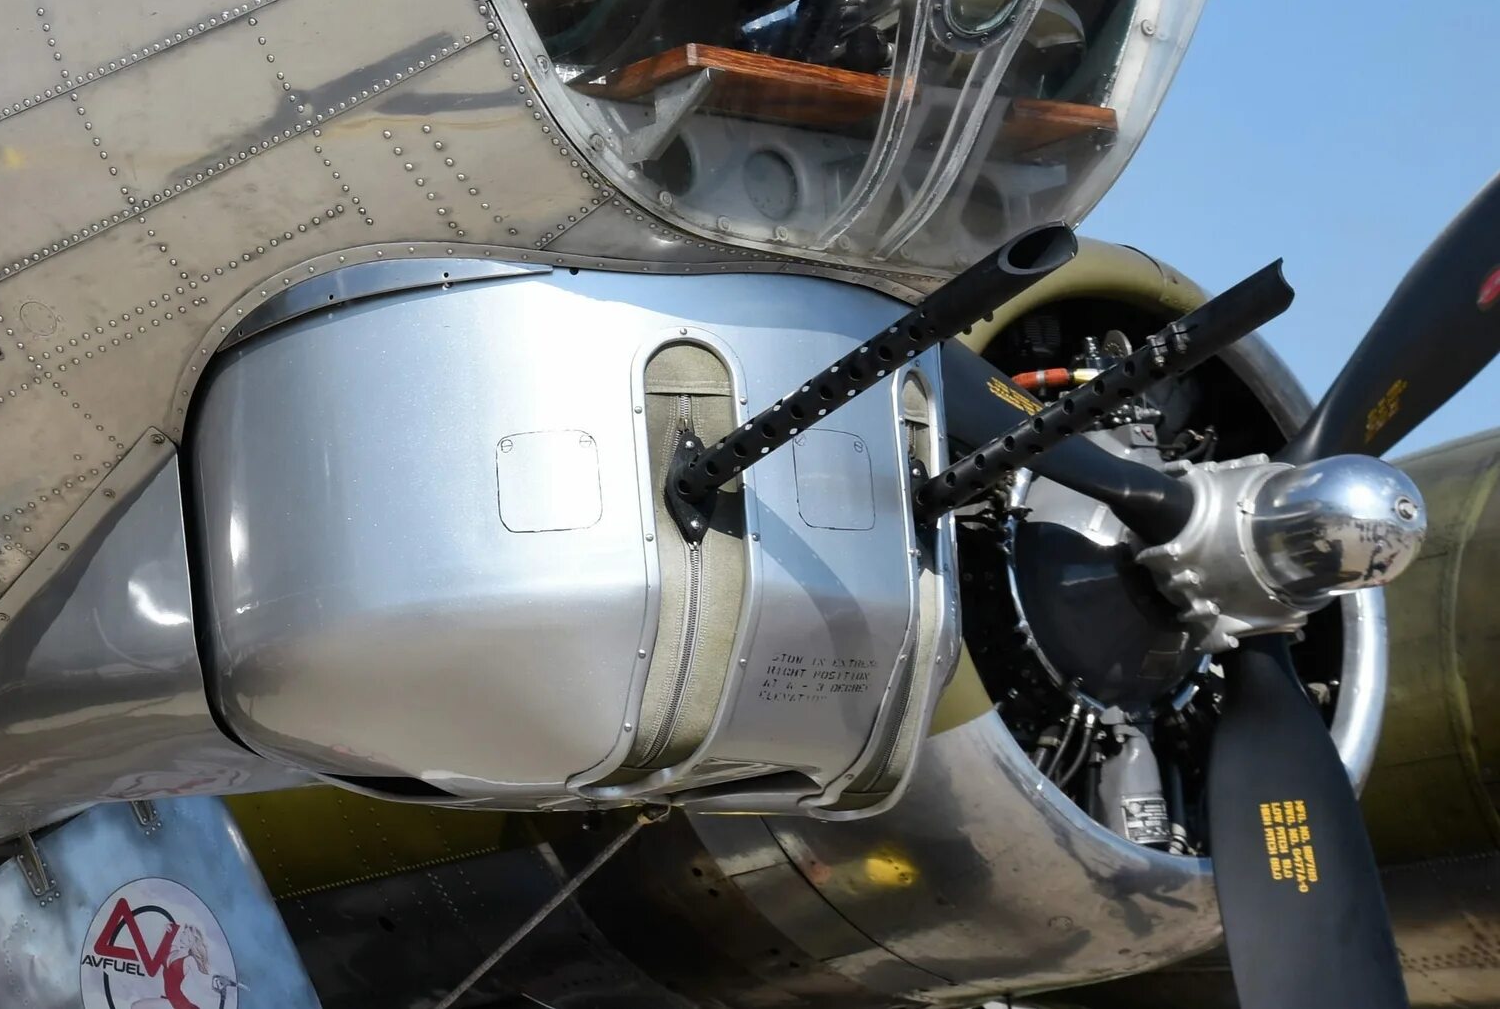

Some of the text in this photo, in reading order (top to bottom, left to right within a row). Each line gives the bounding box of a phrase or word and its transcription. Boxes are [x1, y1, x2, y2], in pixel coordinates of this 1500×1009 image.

[767, 665, 870, 681] RIGHT POSITION
[1260, 804, 1272, 824] HIGH
[1271, 803, 1283, 822] LOW
[1265, 828, 1277, 854] PITCH
[1276, 827, 1288, 852] PITCH
[81, 954, 145, 977] AVFUEL
